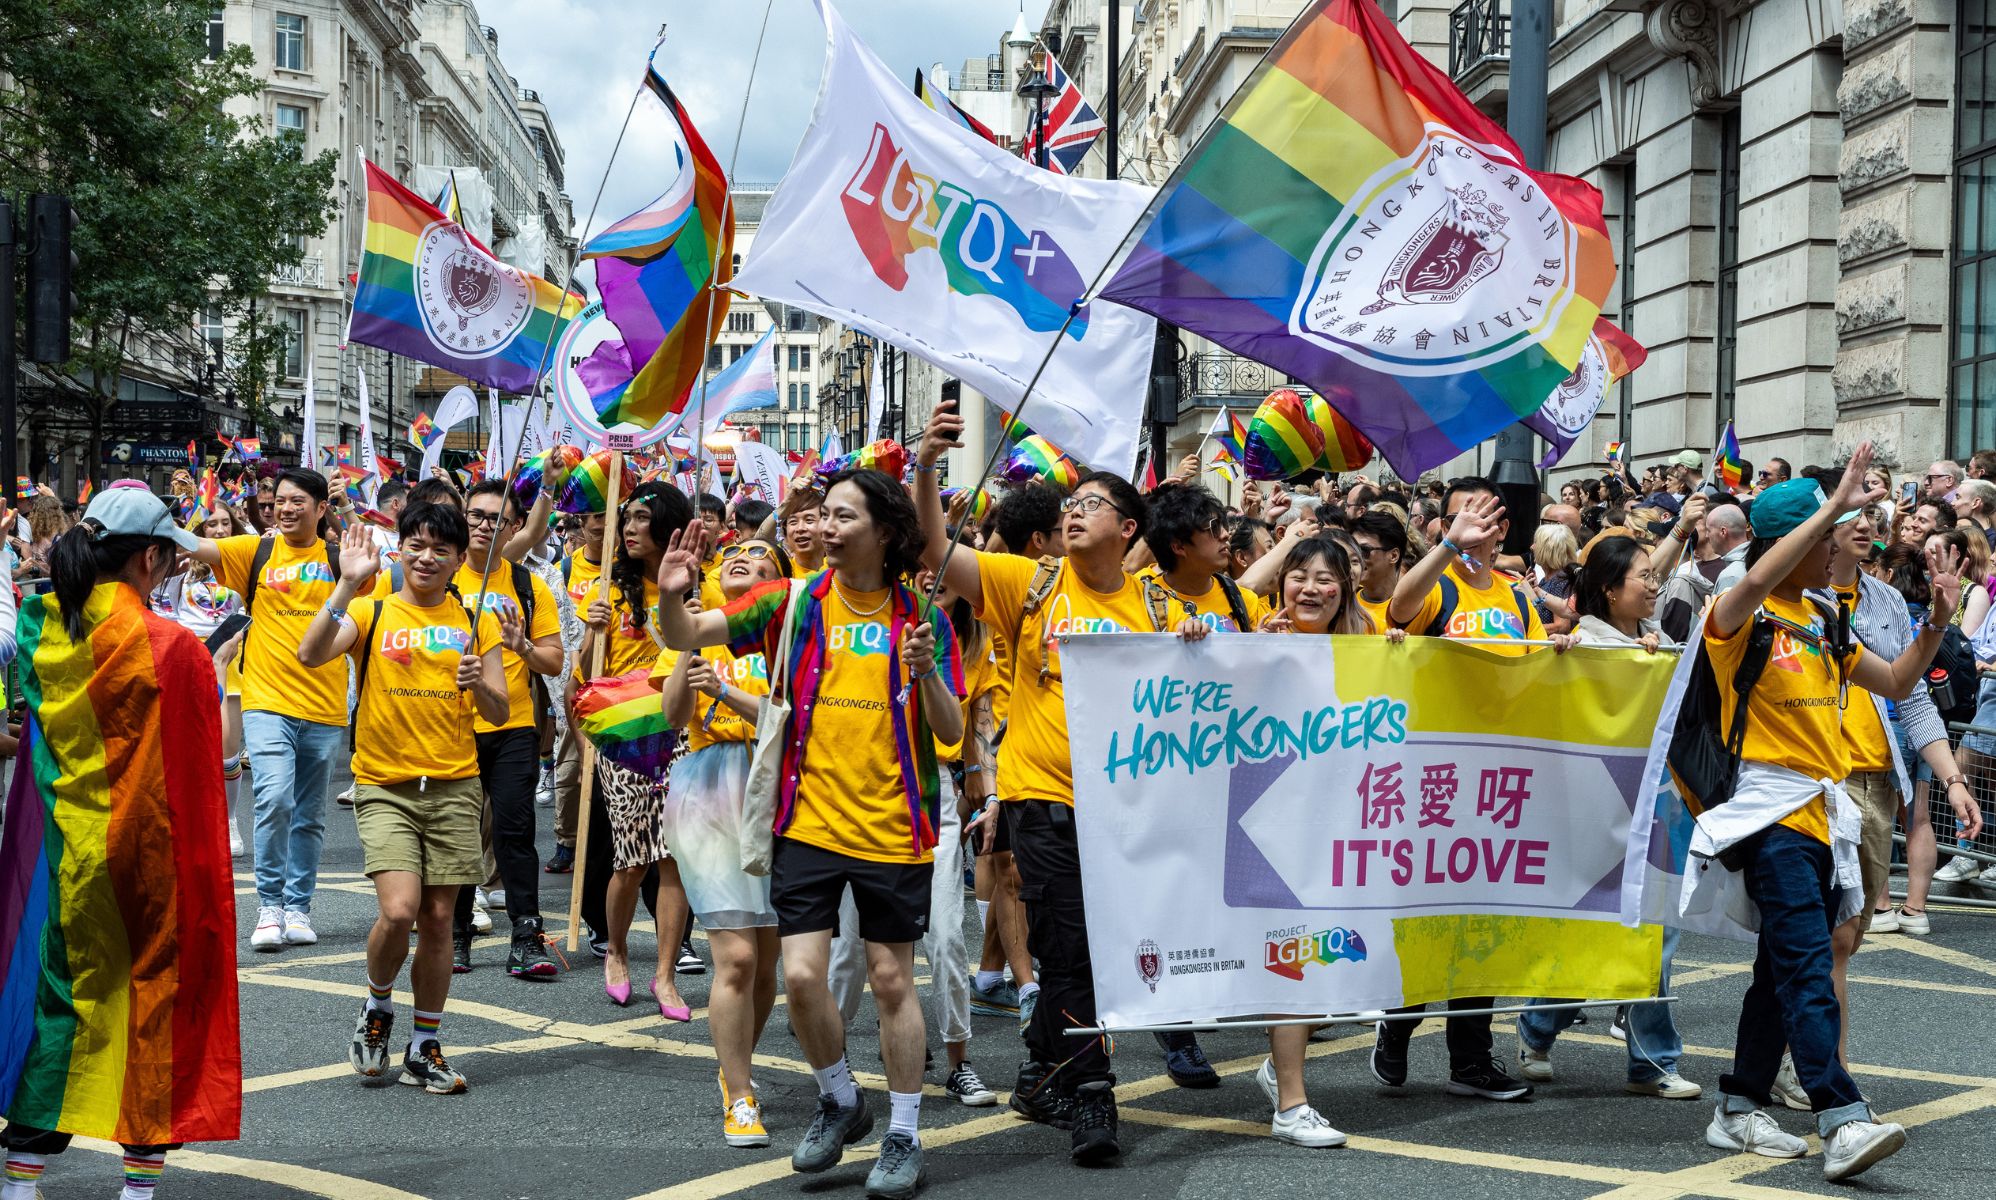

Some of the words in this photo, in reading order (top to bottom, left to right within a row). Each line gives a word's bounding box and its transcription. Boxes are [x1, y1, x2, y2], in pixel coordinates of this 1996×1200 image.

[1453, 258, 1562, 346] BRITAIN
[140, 448, 188, 458] PHANTOM
[265, 561, 327, 583] LGBTQ+
[381, 625, 464, 652] LGBTQ+
[389, 687, 458, 700] HONGKONGERS
[1133, 675, 1233, 718] WE'RE
[1103, 698, 1407, 783] HONGKONGERS
[1357, 761, 1534, 829] 係愛呀
[1332, 838, 1414, 886] IT'S
[1424, 837, 1550, 885] LOVE
[1265, 926, 1358, 968] LGBTQ+
[1266, 924, 1308, 940] PROJECT
[1169, 962, 1212, 976] HONGKONGERS
[1213, 961, 1220, 972] IN
[1220, 959, 1246, 971] BRITAIN
